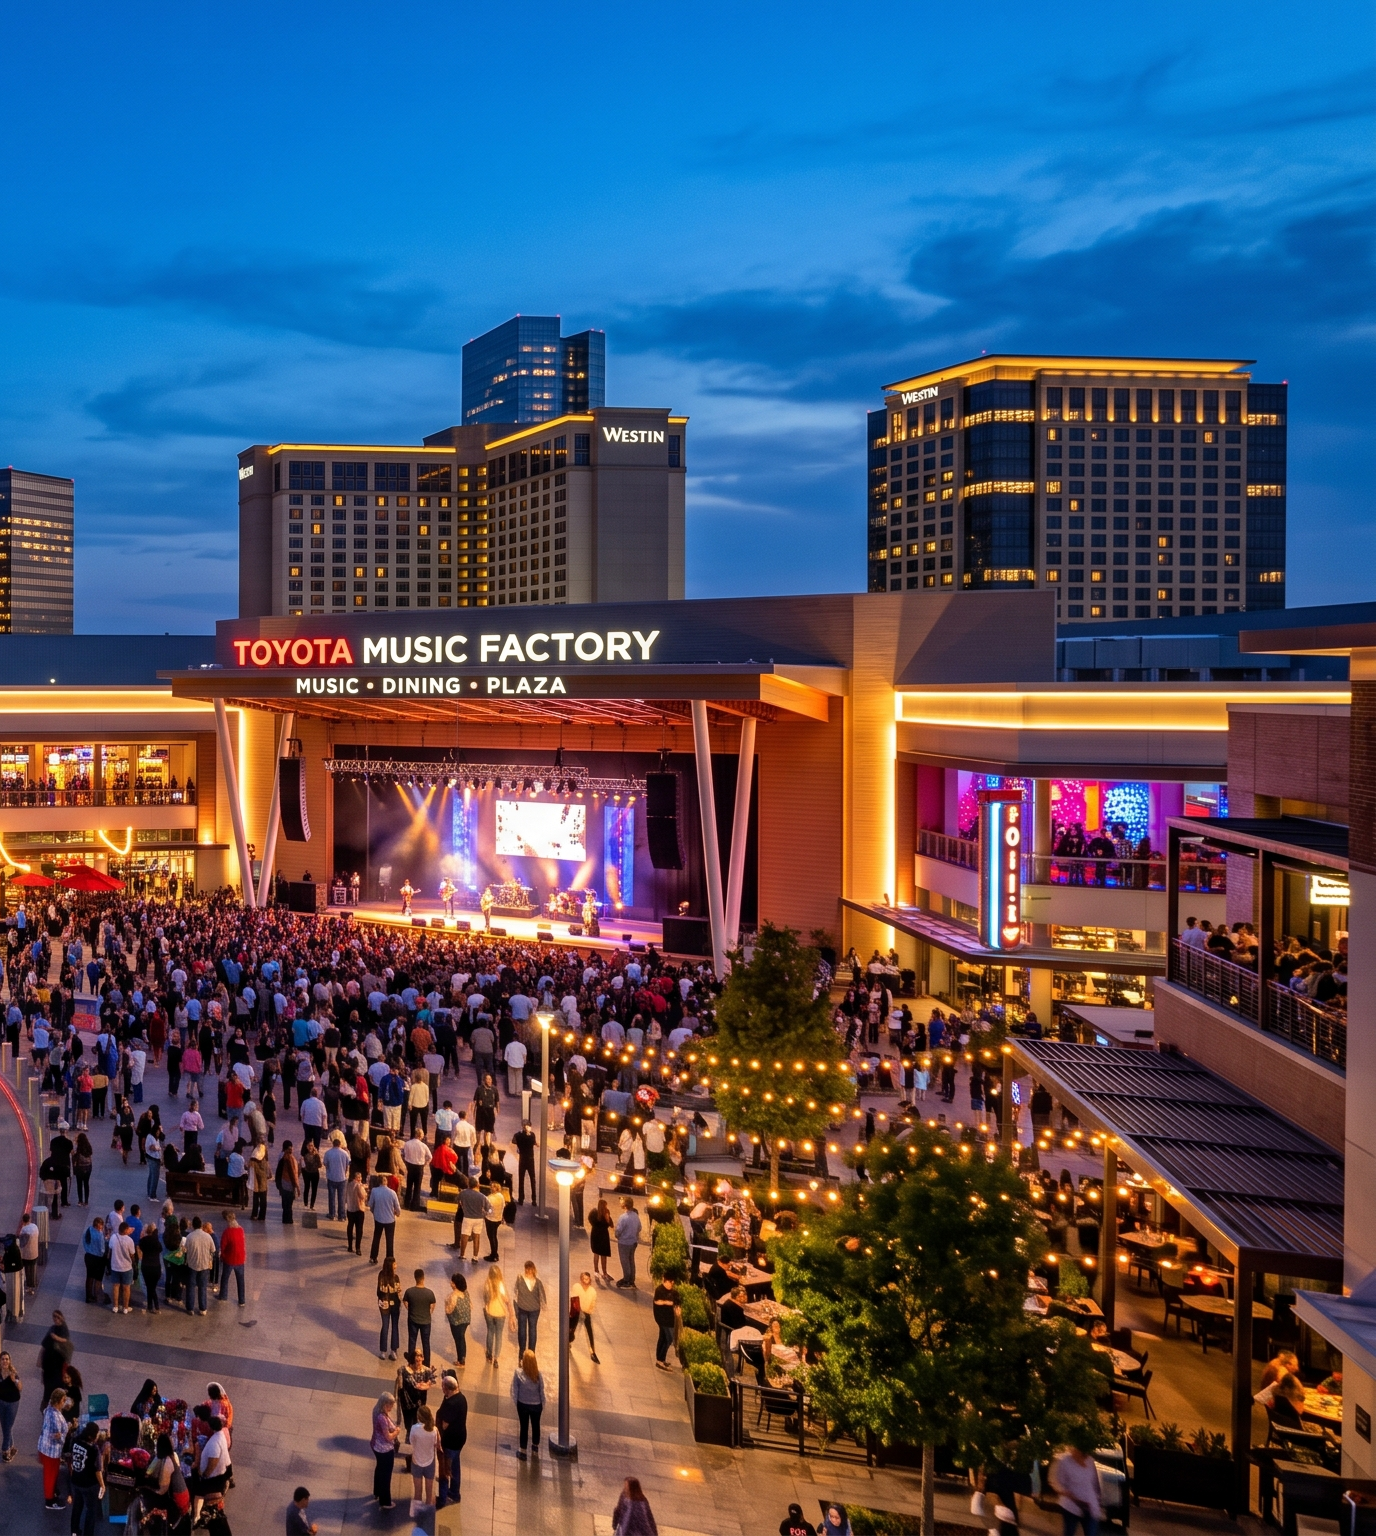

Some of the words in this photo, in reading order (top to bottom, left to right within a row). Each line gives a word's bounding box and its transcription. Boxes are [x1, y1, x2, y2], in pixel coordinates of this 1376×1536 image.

[901, 386, 939, 405] WESTIN
[602, 426, 665, 443] WESTIN
[233, 638, 353, 666] TOYOTA
[363, 635, 468, 664] MUSIC
[480, 630, 660, 662] FACTORY
[296, 677, 359, 694] MUSIC
[382, 677, 461, 694] DINING
[487, 677, 567, 694] PLAZA
